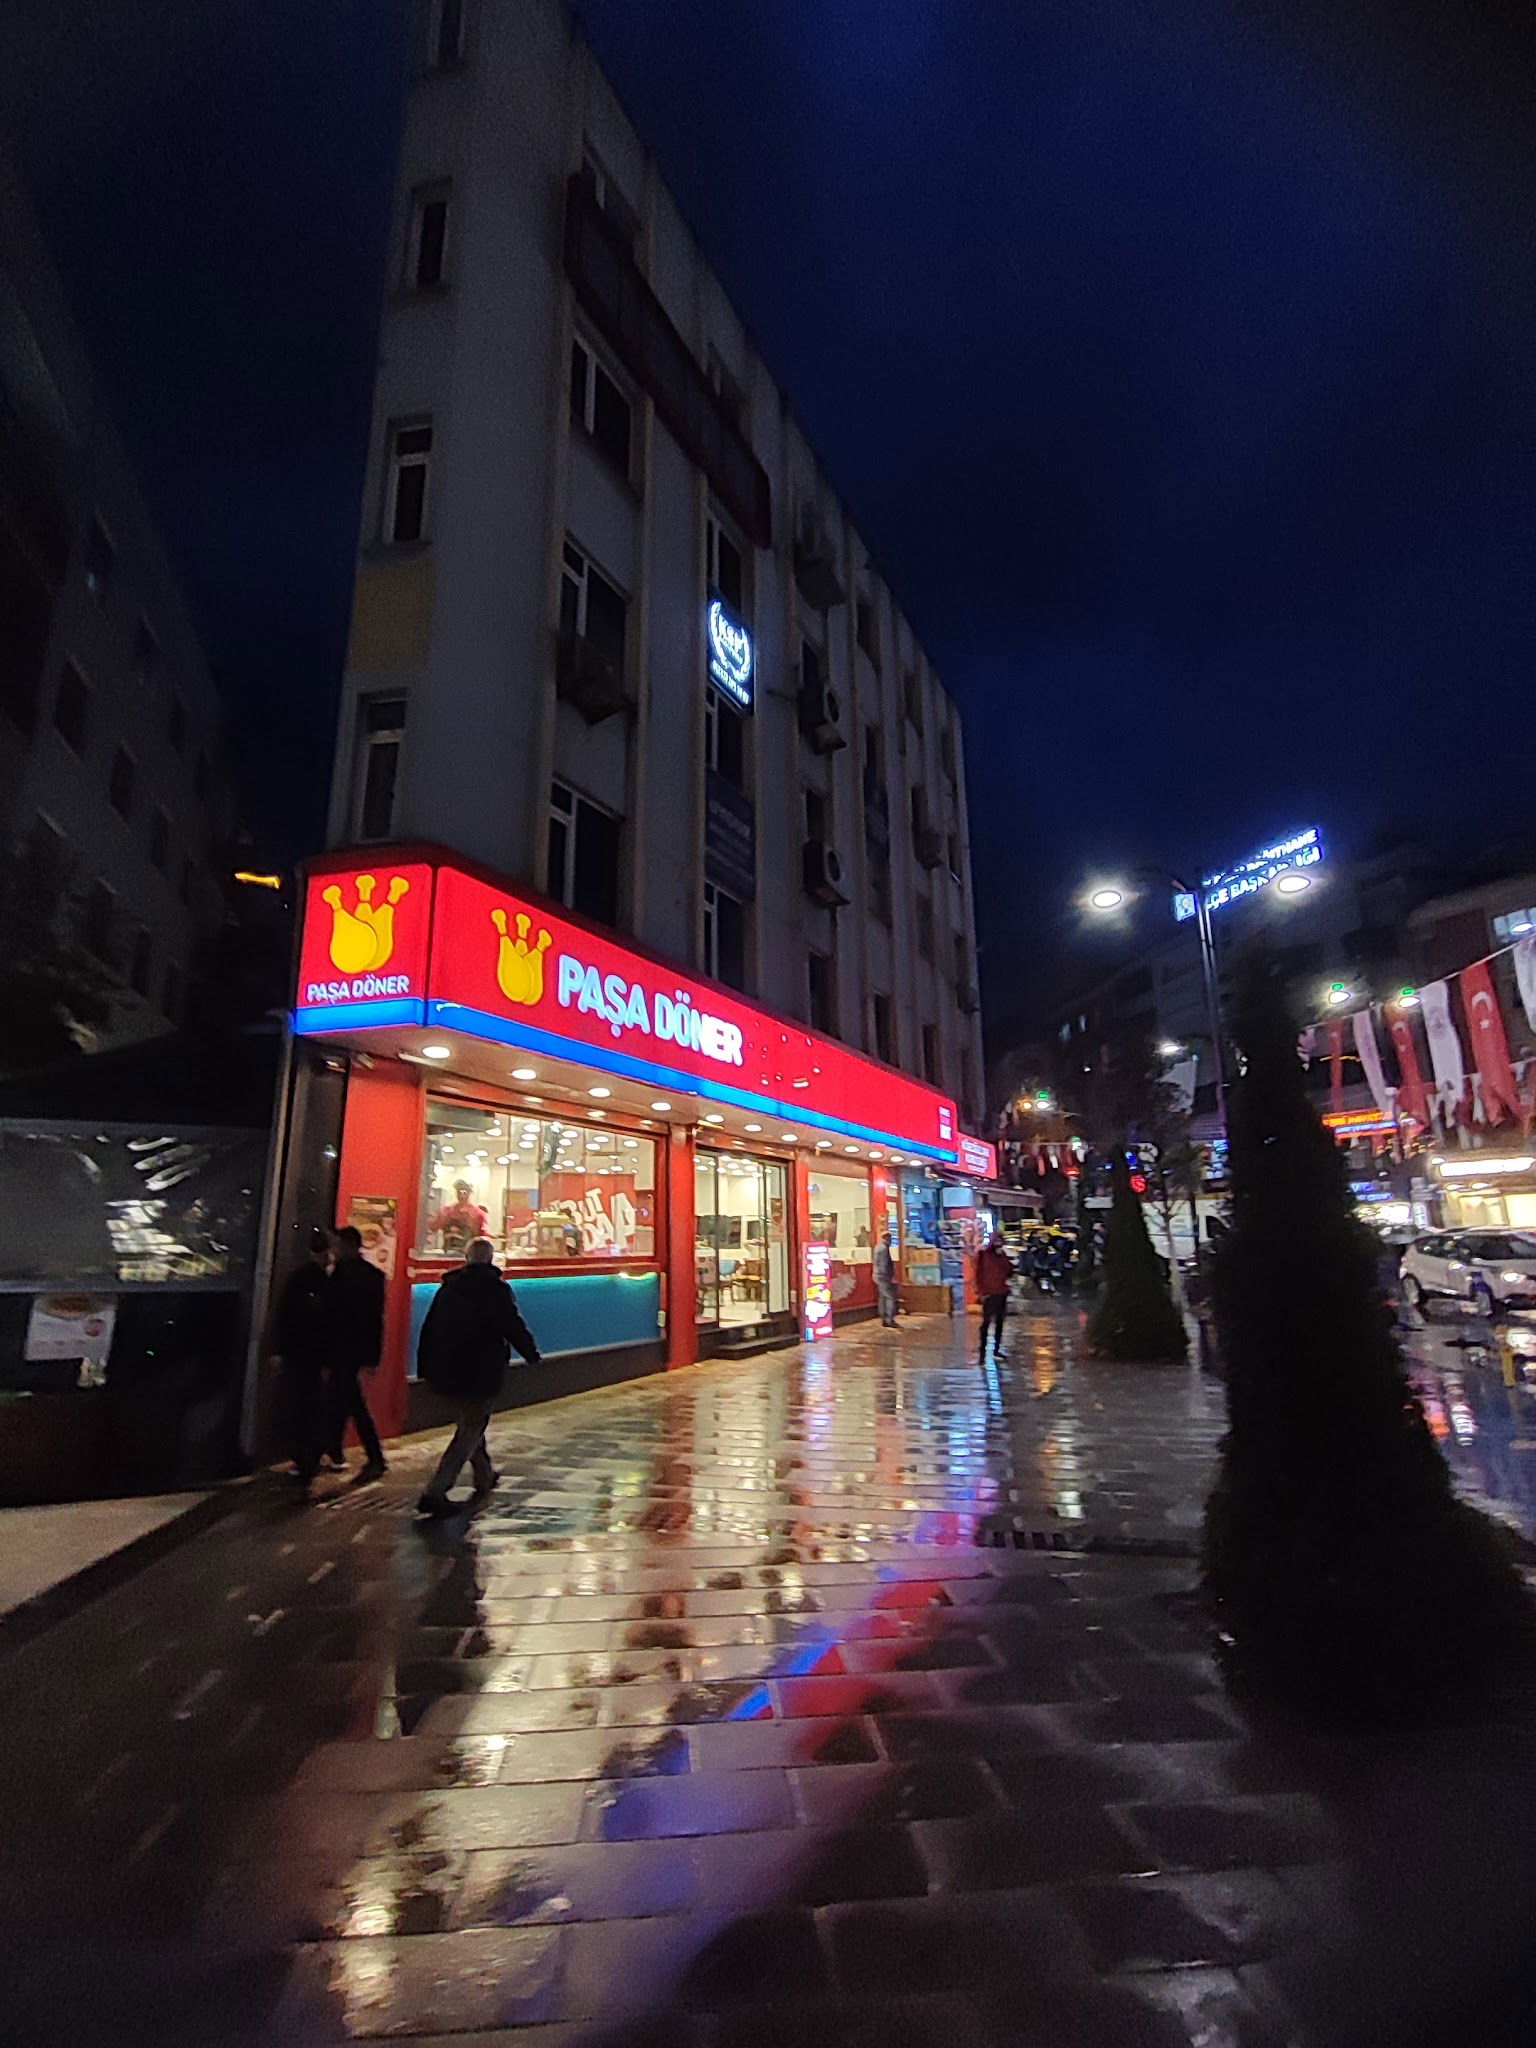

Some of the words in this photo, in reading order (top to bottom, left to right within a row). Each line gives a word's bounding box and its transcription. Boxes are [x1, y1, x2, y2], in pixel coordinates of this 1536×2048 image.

[1230, 846, 1321, 898] BAŞKANIĞI
[306, 980, 350, 1005] PAŞA
[351, 973, 410, 998] DÖNER
[557, 954, 651, 1039] PAŞA
[654, 989, 744, 1067] DÖNER
